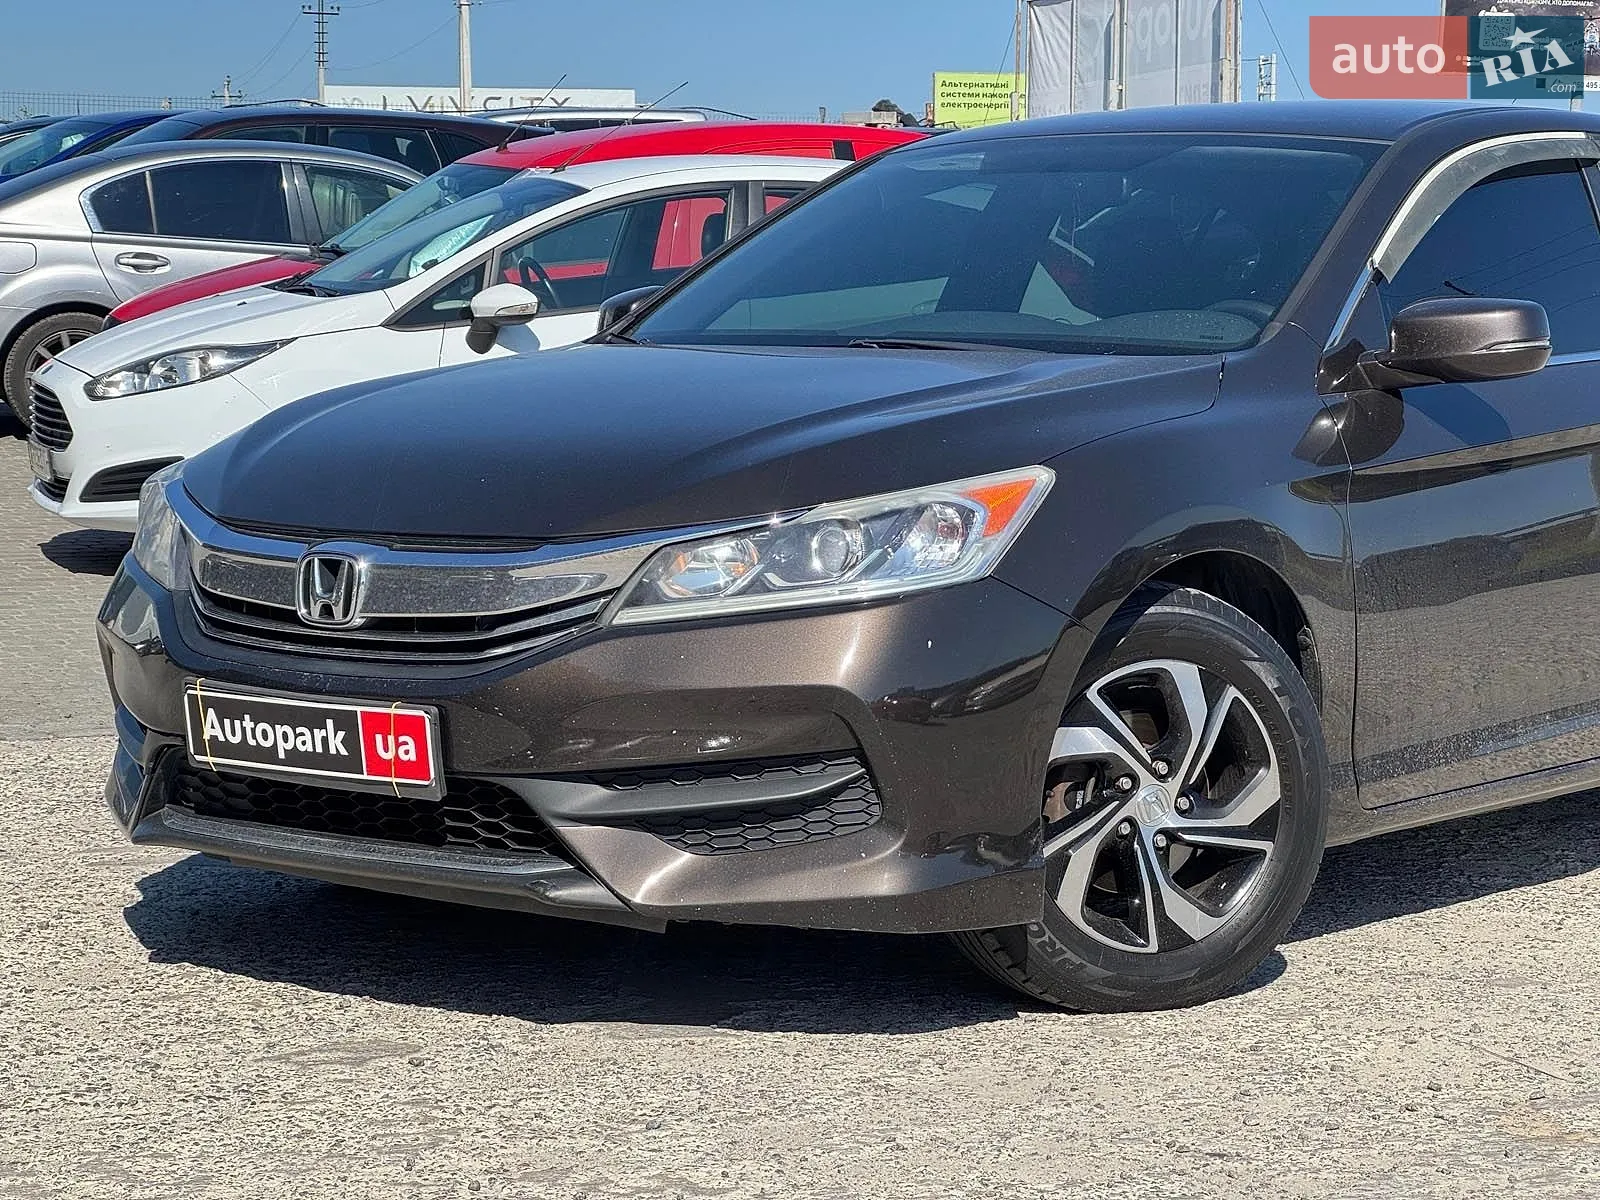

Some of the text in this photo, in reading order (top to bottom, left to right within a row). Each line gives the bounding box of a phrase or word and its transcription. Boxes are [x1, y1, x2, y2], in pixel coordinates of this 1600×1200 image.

[940, 80, 1009, 89] Альтернативні
[940, 91, 981, 99] системи
[940, 101, 1010, 111] електроенергії
[203, 707, 417, 762] Autopark ua
